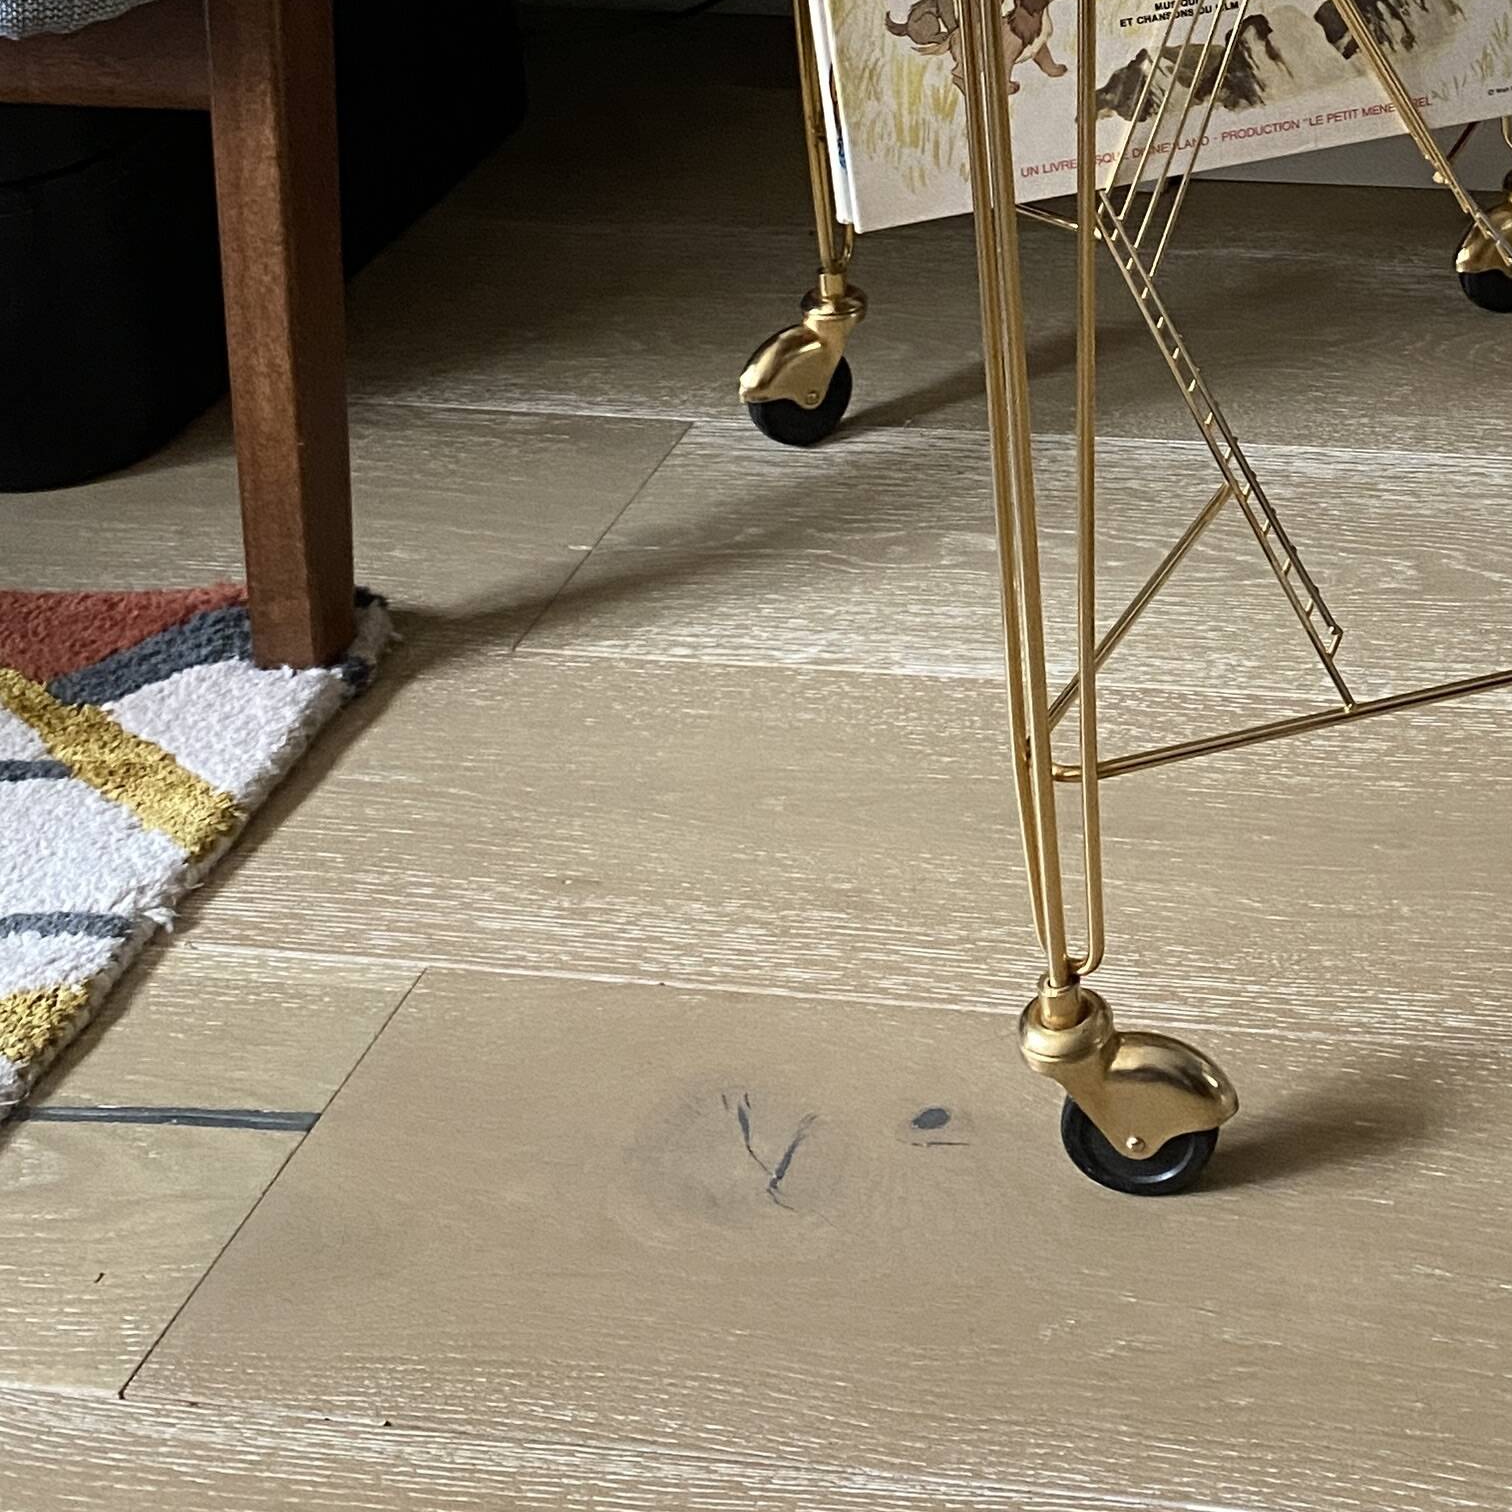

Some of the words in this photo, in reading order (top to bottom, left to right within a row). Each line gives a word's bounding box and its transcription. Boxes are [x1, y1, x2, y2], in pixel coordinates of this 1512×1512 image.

[1119, 17, 1133, 28] ET
[1221, 119, 1302, 142] PRODUCTION
[1325, 108, 1358, 124] PETIT
[1361, 96, 1432, 117] MENEREL
[1020, 164, 1039, 178] UN
